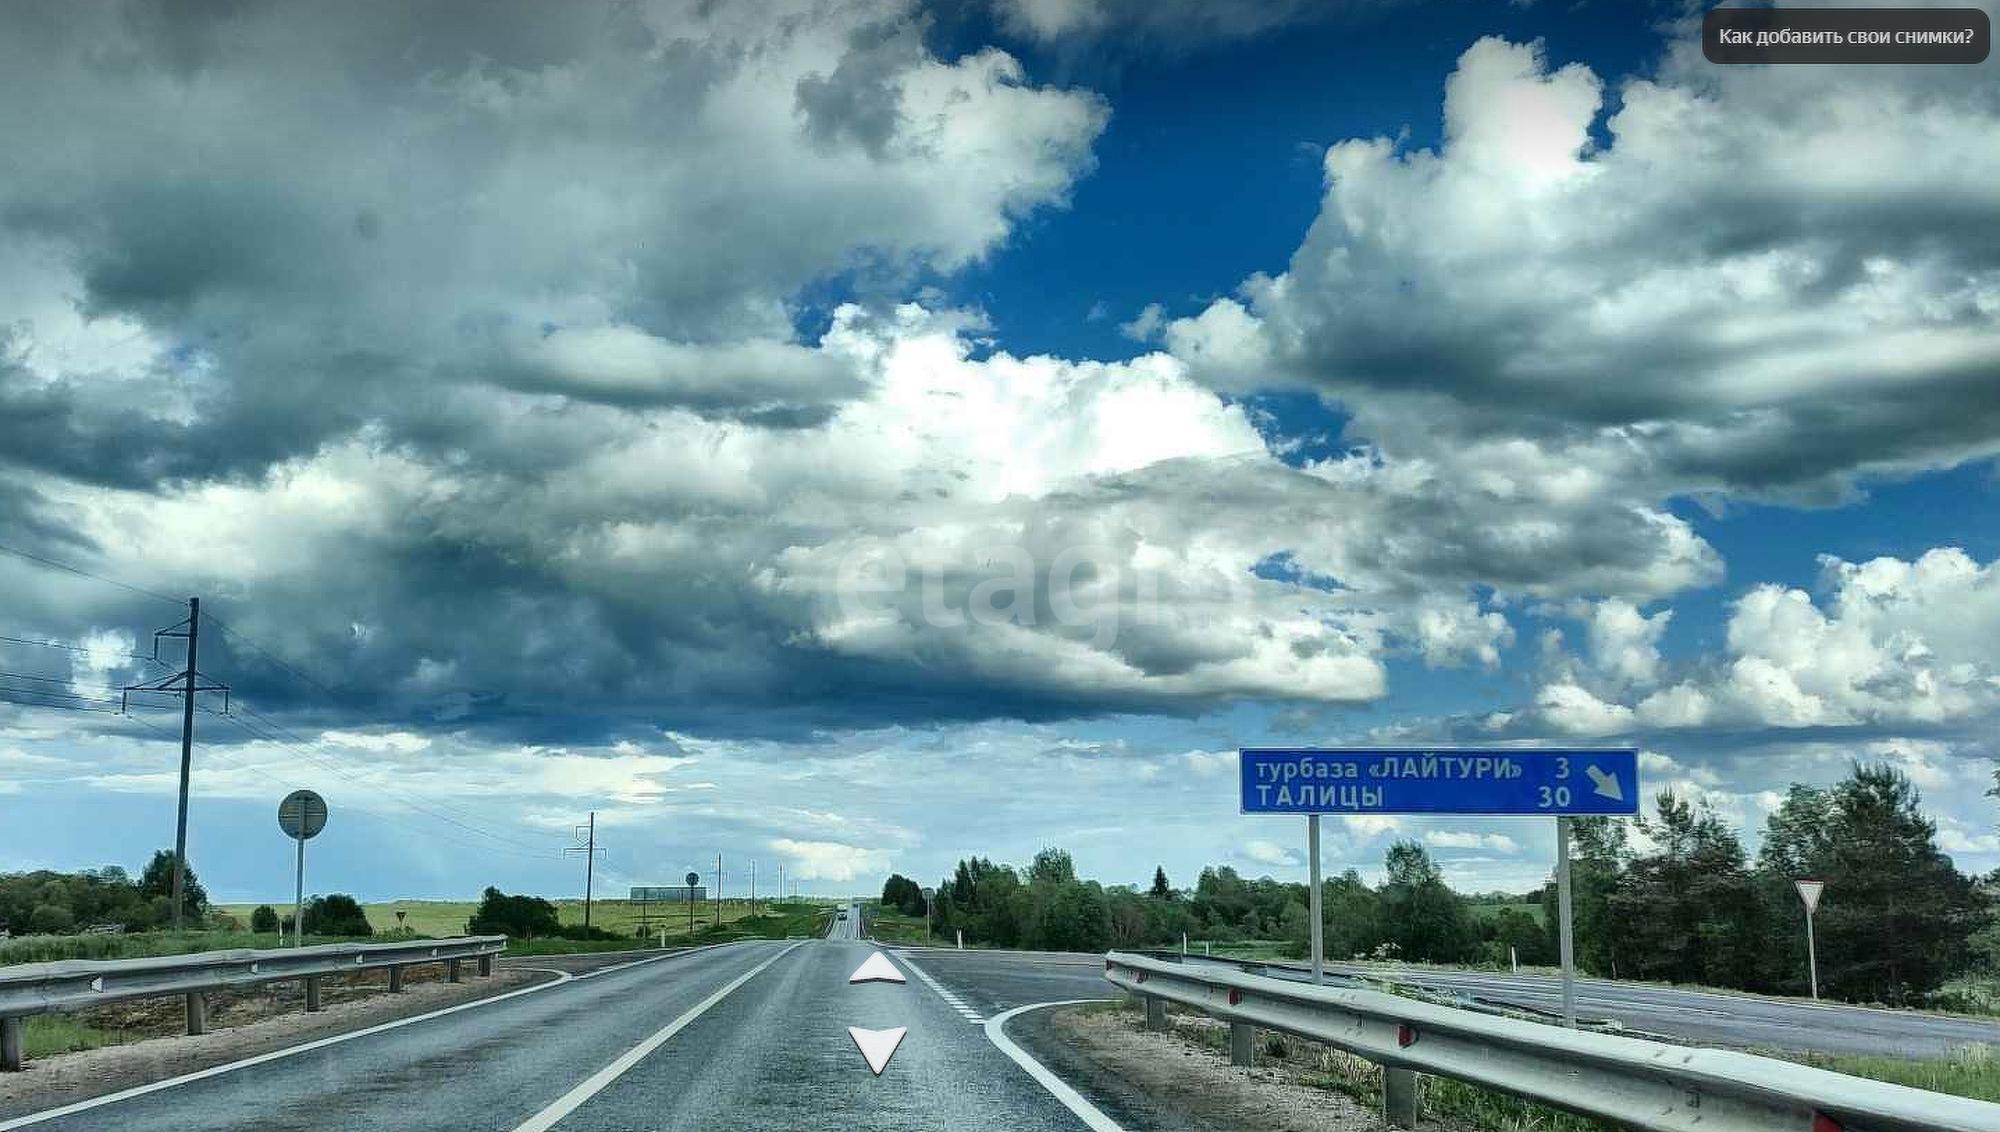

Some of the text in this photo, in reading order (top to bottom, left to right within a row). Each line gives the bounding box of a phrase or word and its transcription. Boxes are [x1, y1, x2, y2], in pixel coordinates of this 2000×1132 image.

[1256, 753, 1570, 782] турбаза «ЛАЙТУРИ» 3
[1256, 786, 1571, 810] ТАЛИЦЫ 30
